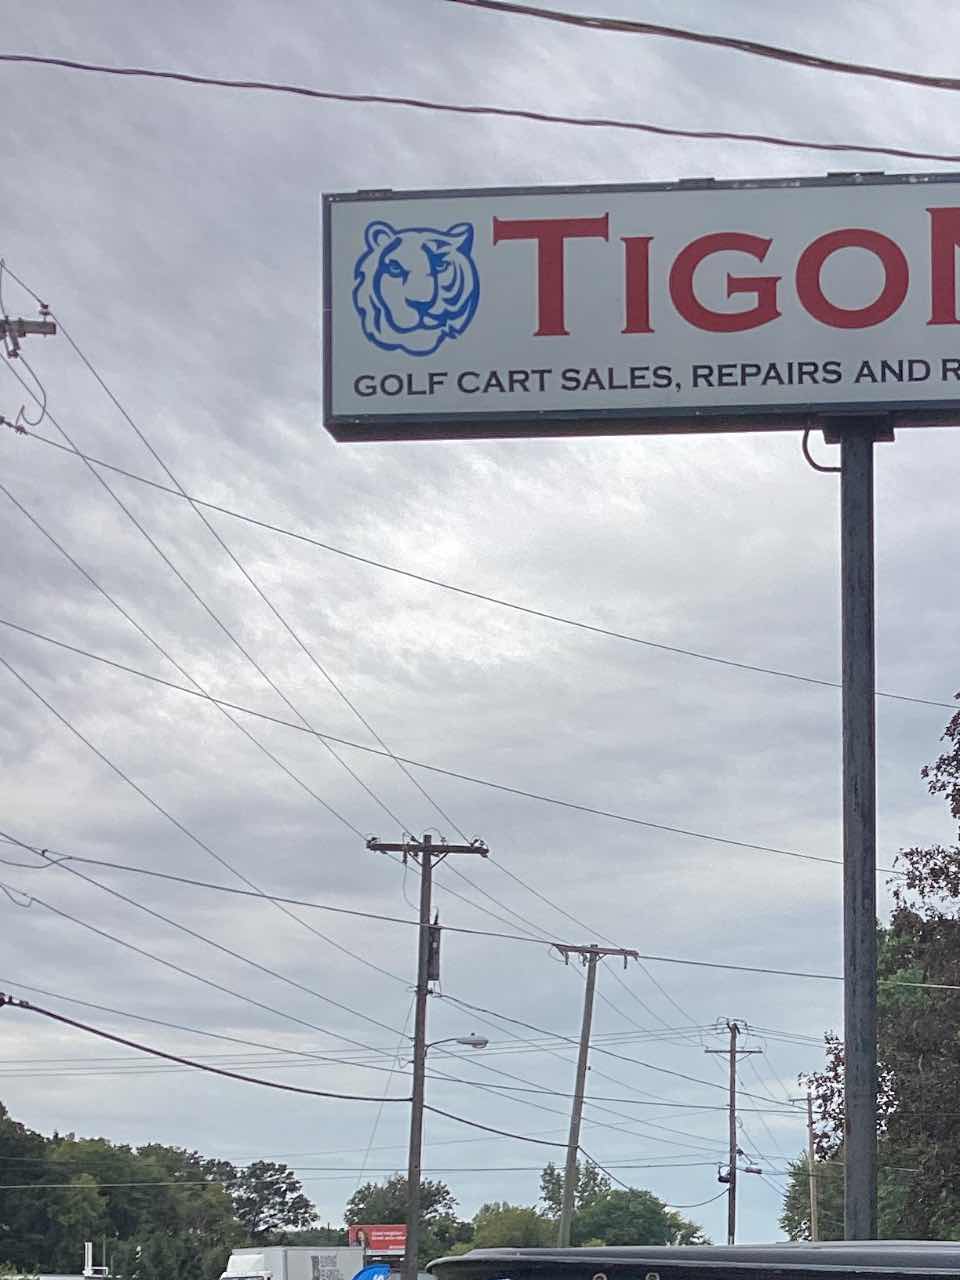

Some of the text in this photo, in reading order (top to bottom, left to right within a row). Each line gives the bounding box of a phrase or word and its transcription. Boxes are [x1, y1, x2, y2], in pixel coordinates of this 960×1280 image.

[353, 372, 448, 397] GOLF
[457, 369, 552, 395] CART
[560, 365, 682, 393] SALES,
[692, 361, 843, 388] REPAIRS
[855, 358, 931, 384] AND
